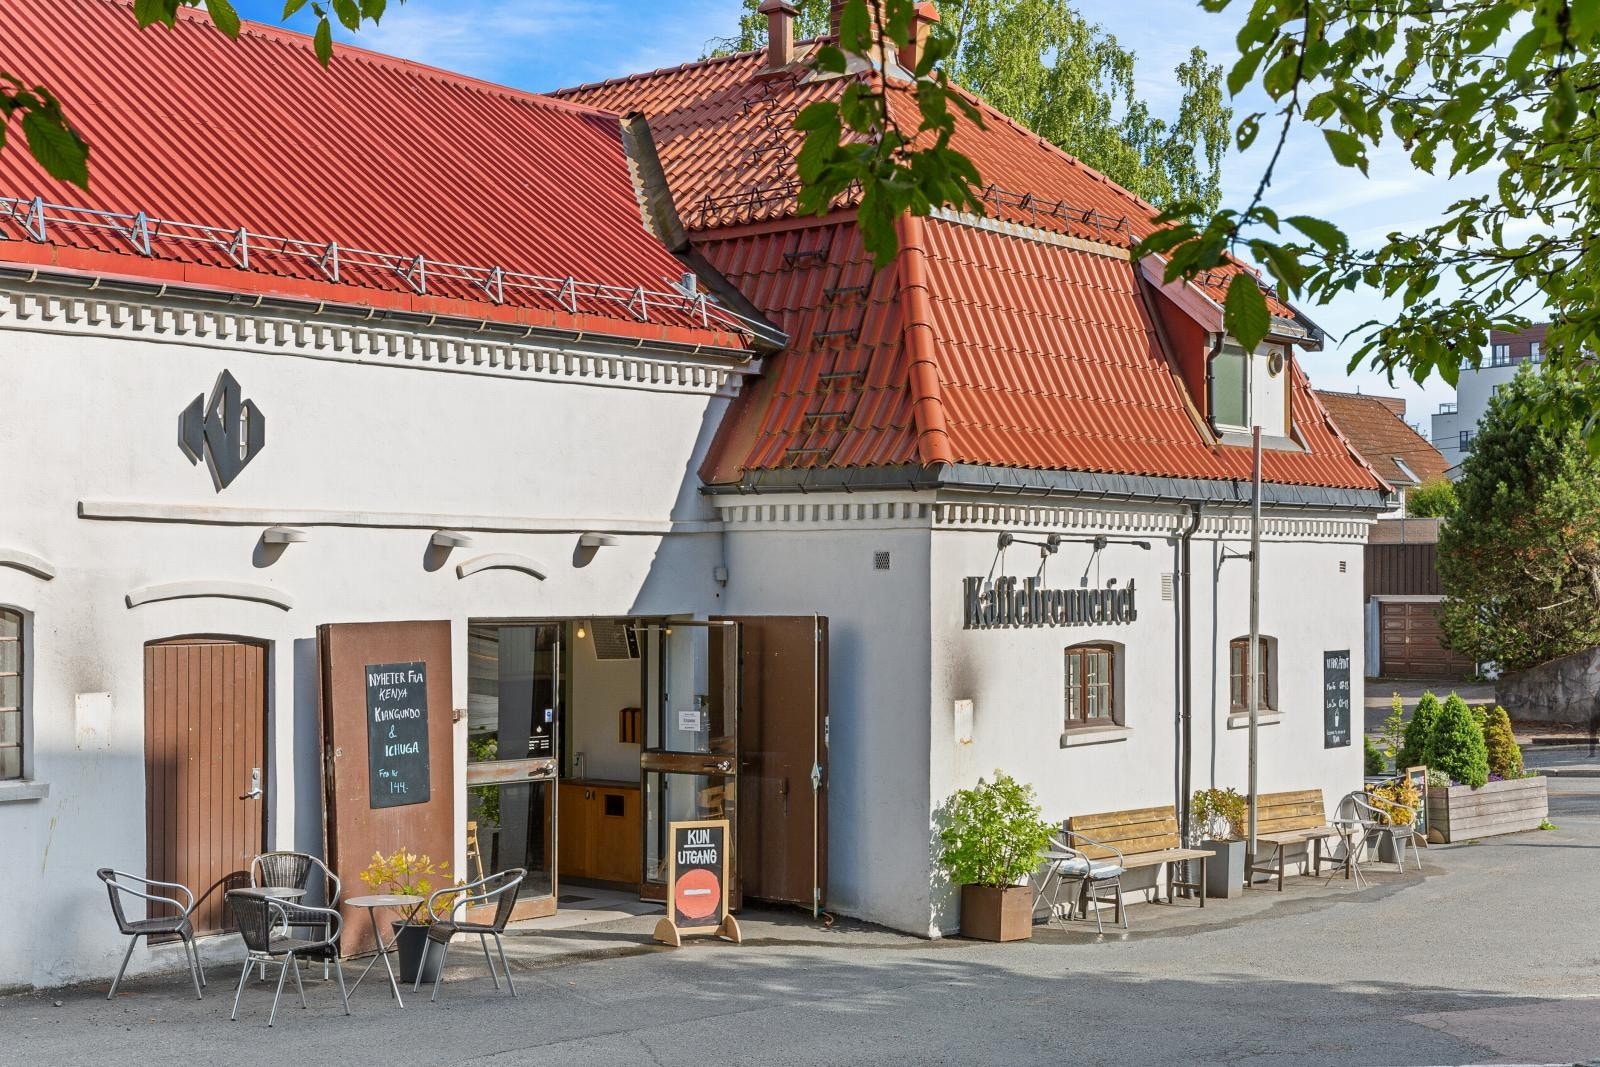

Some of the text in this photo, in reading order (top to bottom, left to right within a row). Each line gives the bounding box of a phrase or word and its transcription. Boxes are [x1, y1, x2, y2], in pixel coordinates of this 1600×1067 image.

[962, 575, 1138, 630] Kaffebrenneriet
[368, 672, 406, 687] NYHETER
[378, 688, 408, 702] KENYA
[388, 724, 397, 739] &
[385, 741, 420, 757] ICHUGA
[688, 829, 710, 844] KUN
[678, 849, 717, 865] UTGANG
